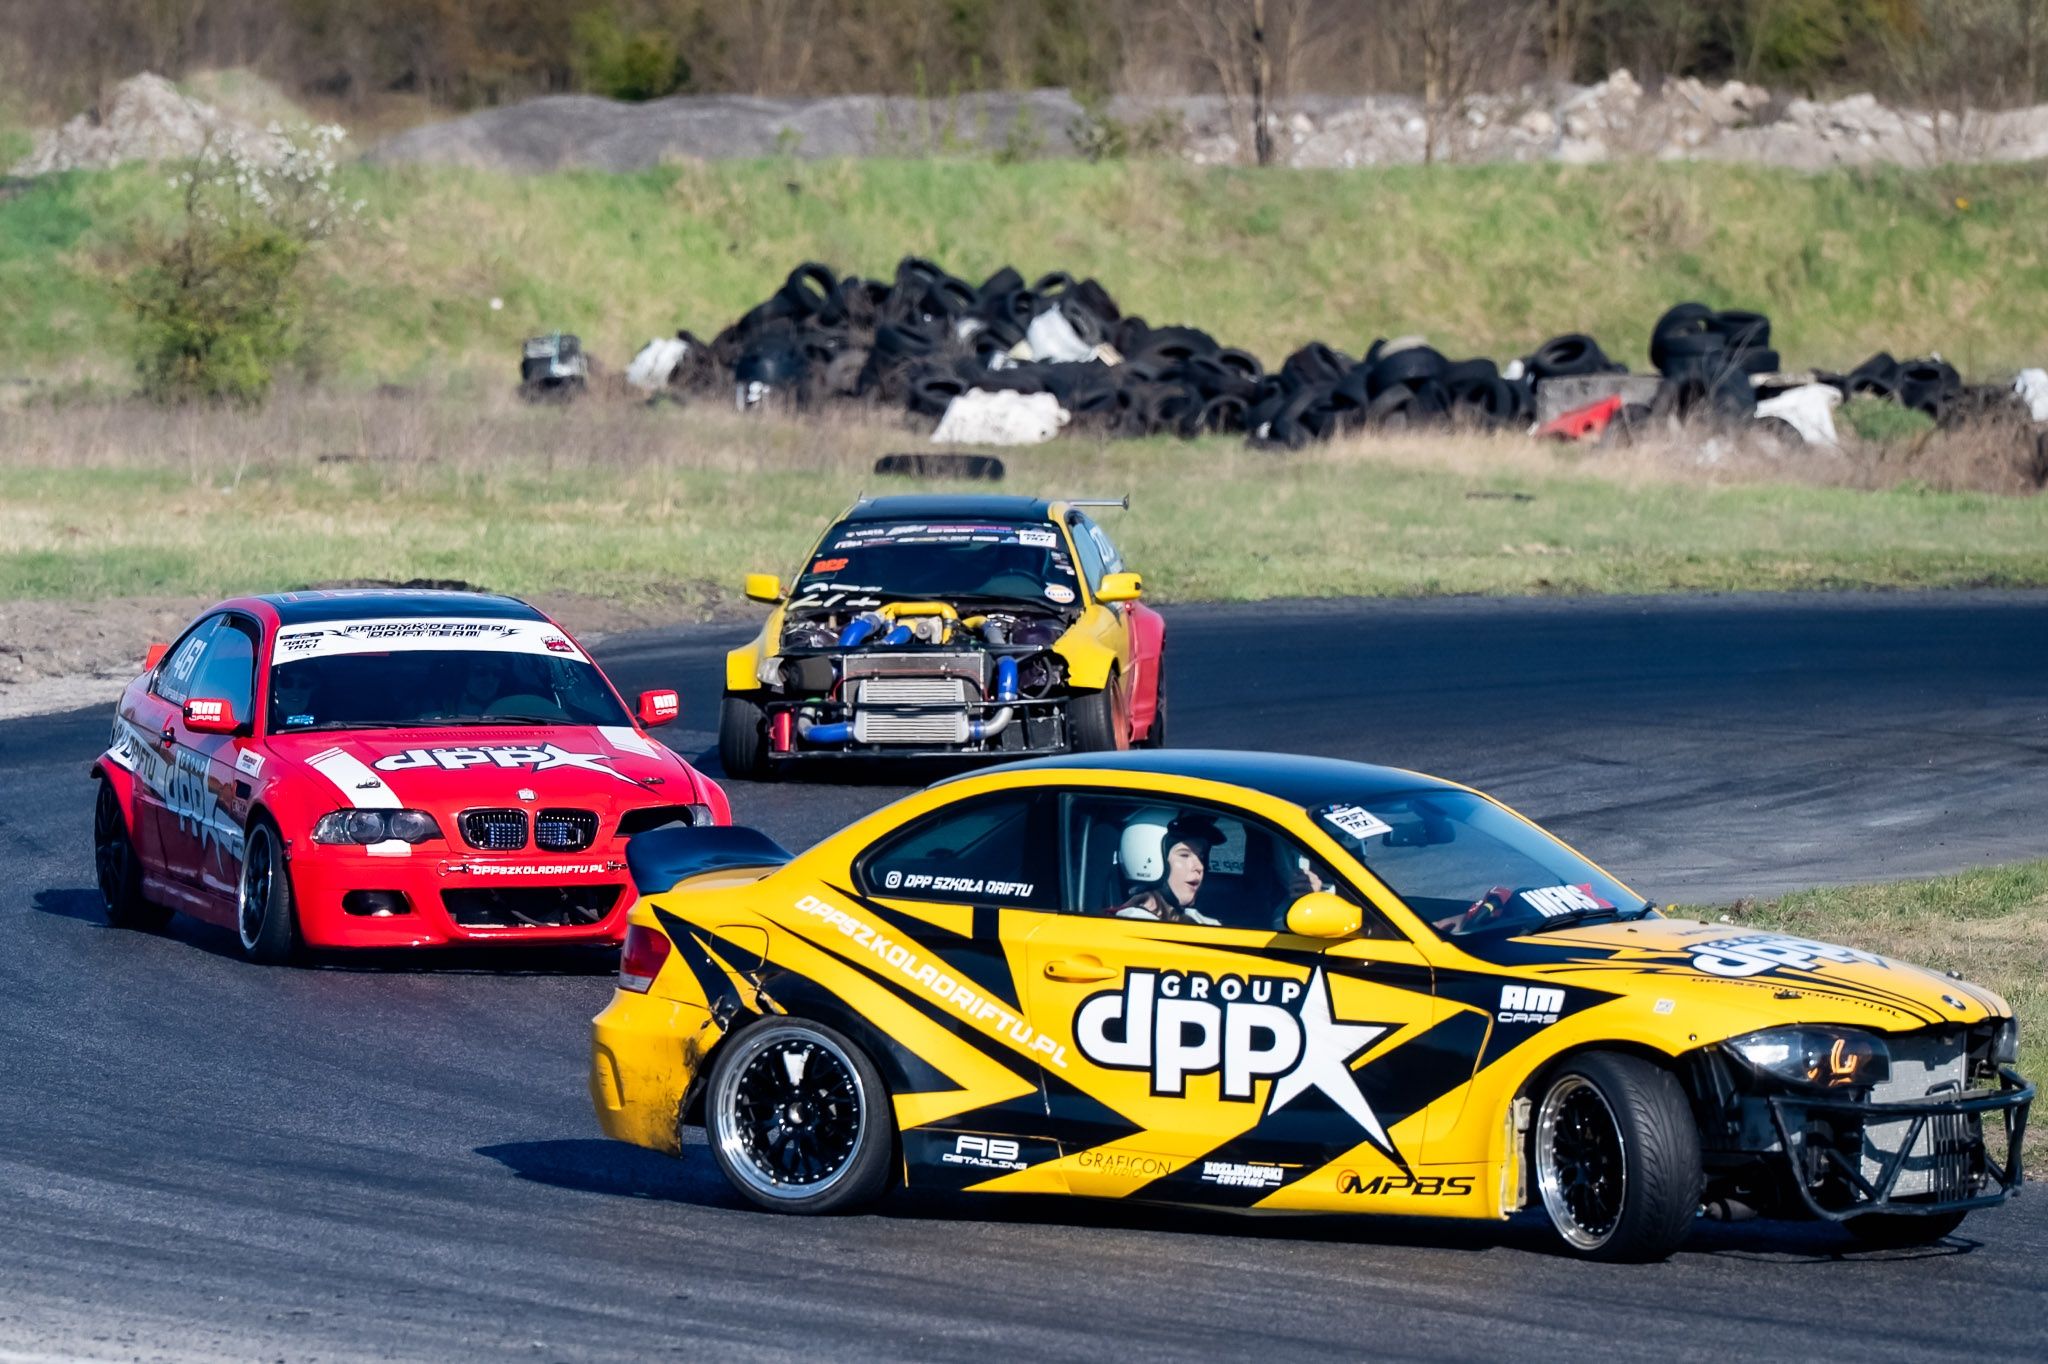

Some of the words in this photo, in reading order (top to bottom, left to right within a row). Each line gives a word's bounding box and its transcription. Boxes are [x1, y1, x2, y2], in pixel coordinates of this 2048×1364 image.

[344, 622, 427, 633] PATRYK
[427, 623, 505, 632] DETMER
[367, 630, 423, 639] DRIFT
[428, 629, 480, 638] TEAM
[288, 643, 318, 651] TAXI
[174, 637, 208, 682] 461
[904, 874, 933, 889] DPP
[932, 876, 984, 893] SZKOŁA
[985, 880, 1034, 897] DRIFTU
[793, 895, 1069, 1069] DPPSZKOLADRIFTU.PL
[1160, 975, 1300, 1003] GROUP
[1500, 985, 1566, 1013] AM
[1497, 1012, 1558, 1024] CARS
[955, 1135, 1020, 1161] AB
[942, 1153, 1028, 1170] DETAILING
[1079, 1151, 1172, 1175] GRAFICON
[1100, 1165, 1143, 1178] STUDIO
[1216, 1174, 1266, 1187] CUSTOMS
[1343, 1175, 1476, 1196] MPBS
